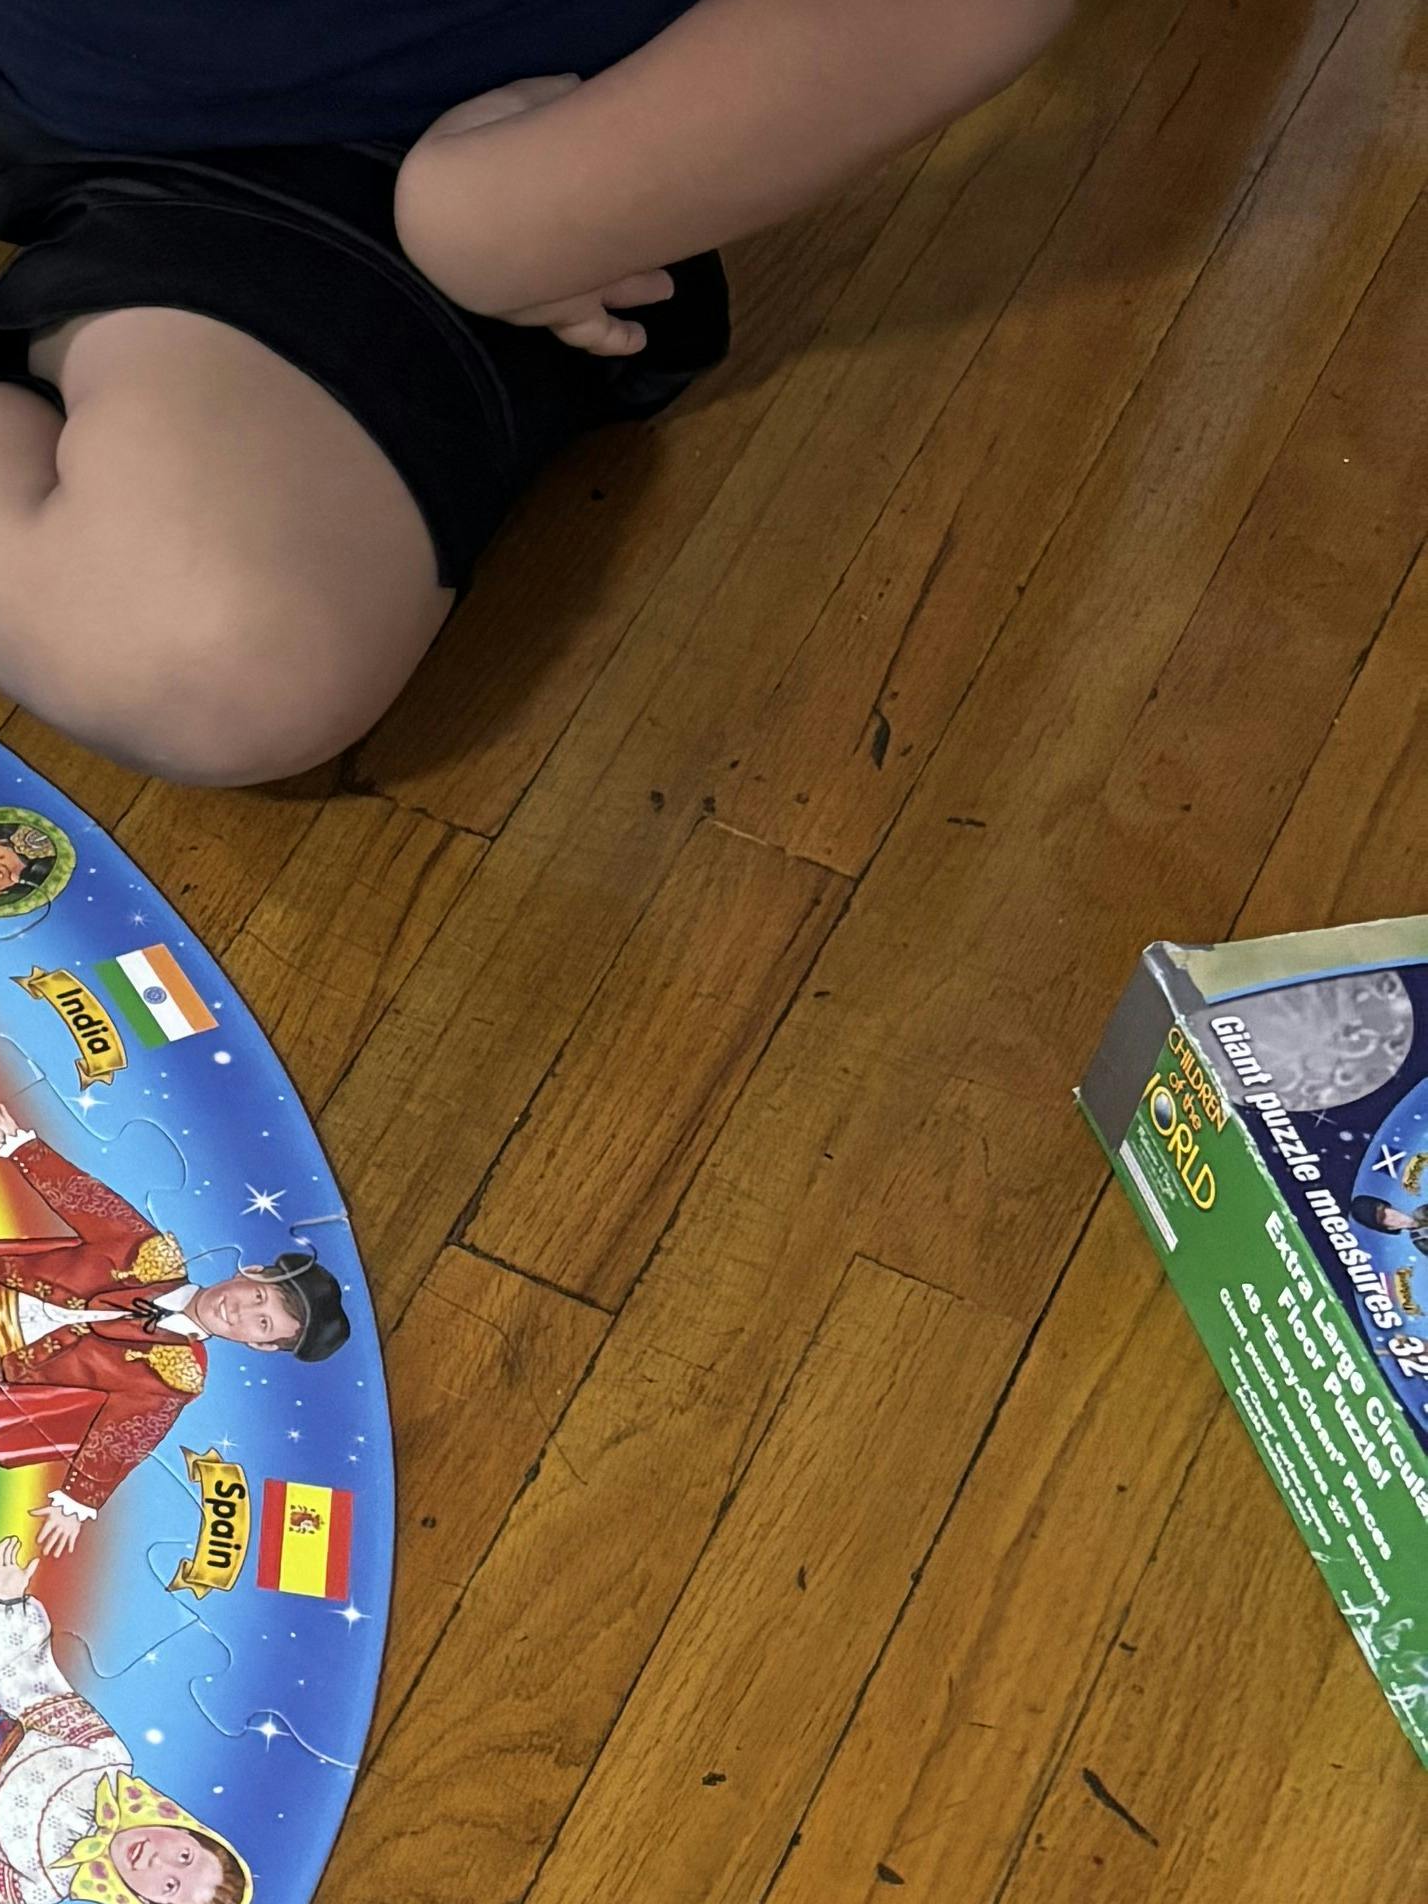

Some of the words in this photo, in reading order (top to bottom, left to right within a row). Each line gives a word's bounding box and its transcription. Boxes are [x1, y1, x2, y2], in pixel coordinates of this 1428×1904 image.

[57, 988, 111, 1055] India
[1168, 1027, 1230, 1134] CHILDREN
[1169, 1072, 1187, 1094] of
[1181, 1092, 1202, 1131] the
[1210, 1015, 1274, 1087] Giant
[1244, 1092, 1321, 1183] puzzle
[1305, 1188, 1403, 1330] measures
[1265, 1210, 1313, 1302] Extra
[1312, 1298, 1366, 1395] Large
[1366, 1396, 1428, 1520] Circula
[1277, 1286, 1326, 1371] Floor
[1323, 1371, 1392, 1490] Puzzle!
[204, 1479, 246, 1569] Spain
[1343, 1470, 1392, 1561] Pieces
